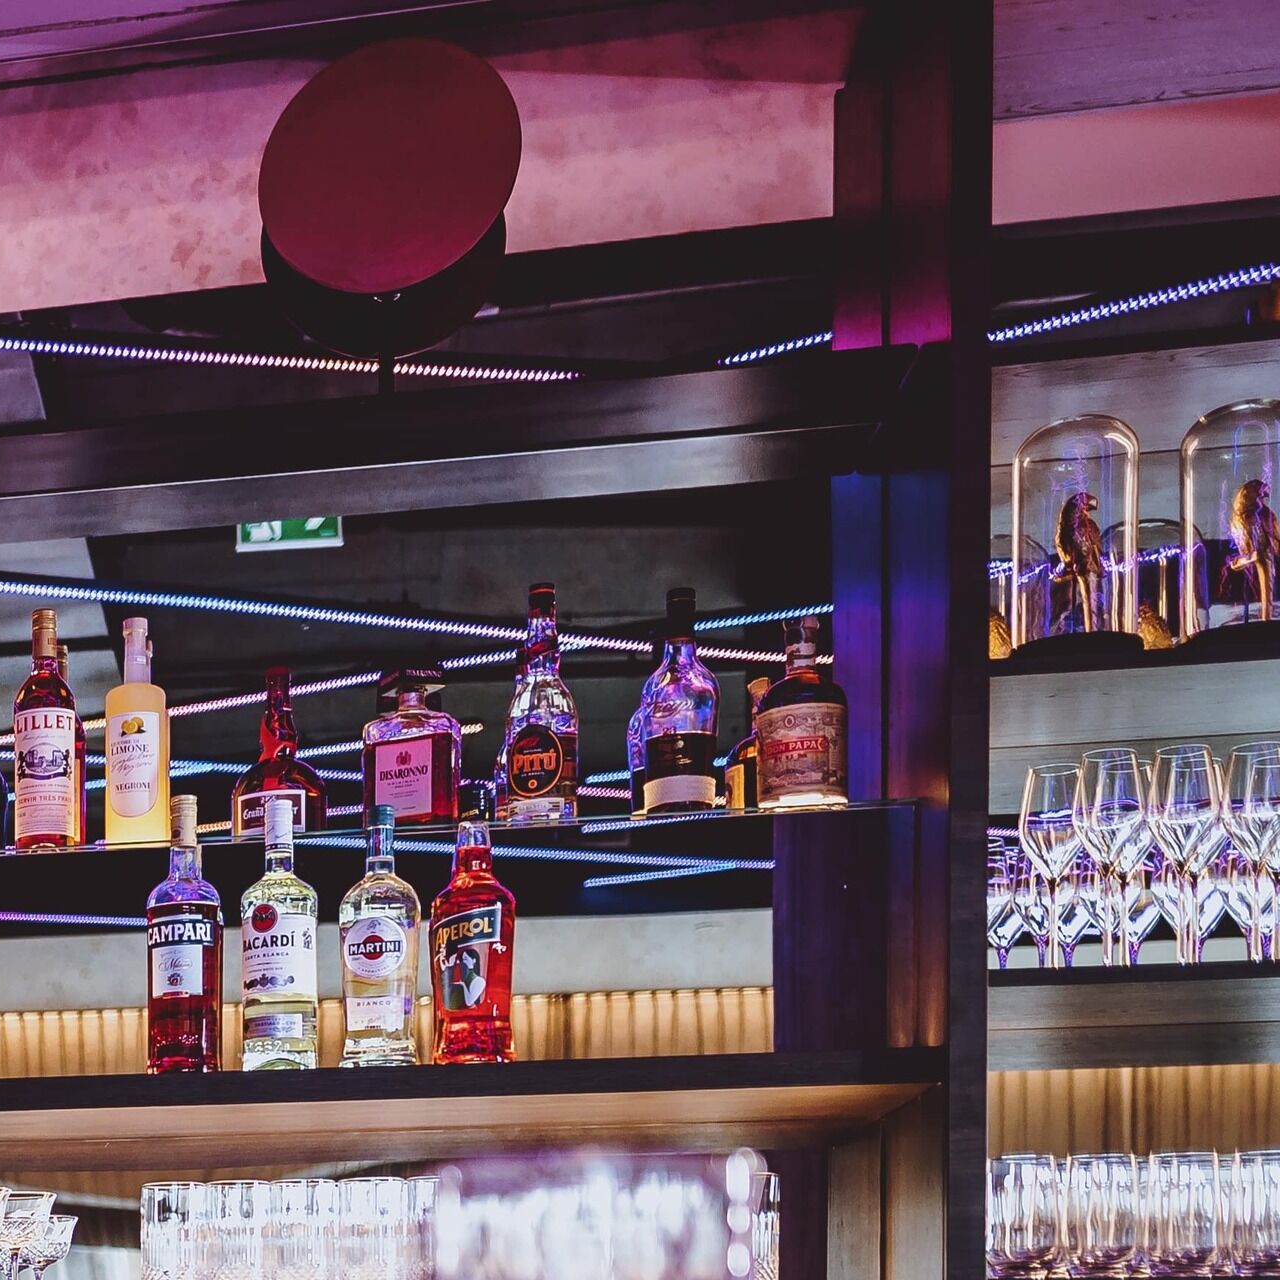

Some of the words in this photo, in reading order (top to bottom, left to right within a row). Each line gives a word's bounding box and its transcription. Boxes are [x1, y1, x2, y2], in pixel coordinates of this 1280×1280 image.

[16, 714, 72, 734] LILLET
[111, 744, 150, 756] LIMONE
[767, 743, 786, 755] DON
[789, 741, 817, 750] PAPA
[513, 748, 557, 774] PITÚ
[380, 764, 428, 781] DISARONNO
[243, 807, 264, 820] Grand
[147, 923, 211, 946] CAMPARI
[243, 931, 295, 953] BACARDÍ
[436, 917, 493, 951] APEROL
[349, 941, 399, 955] MARTINI
